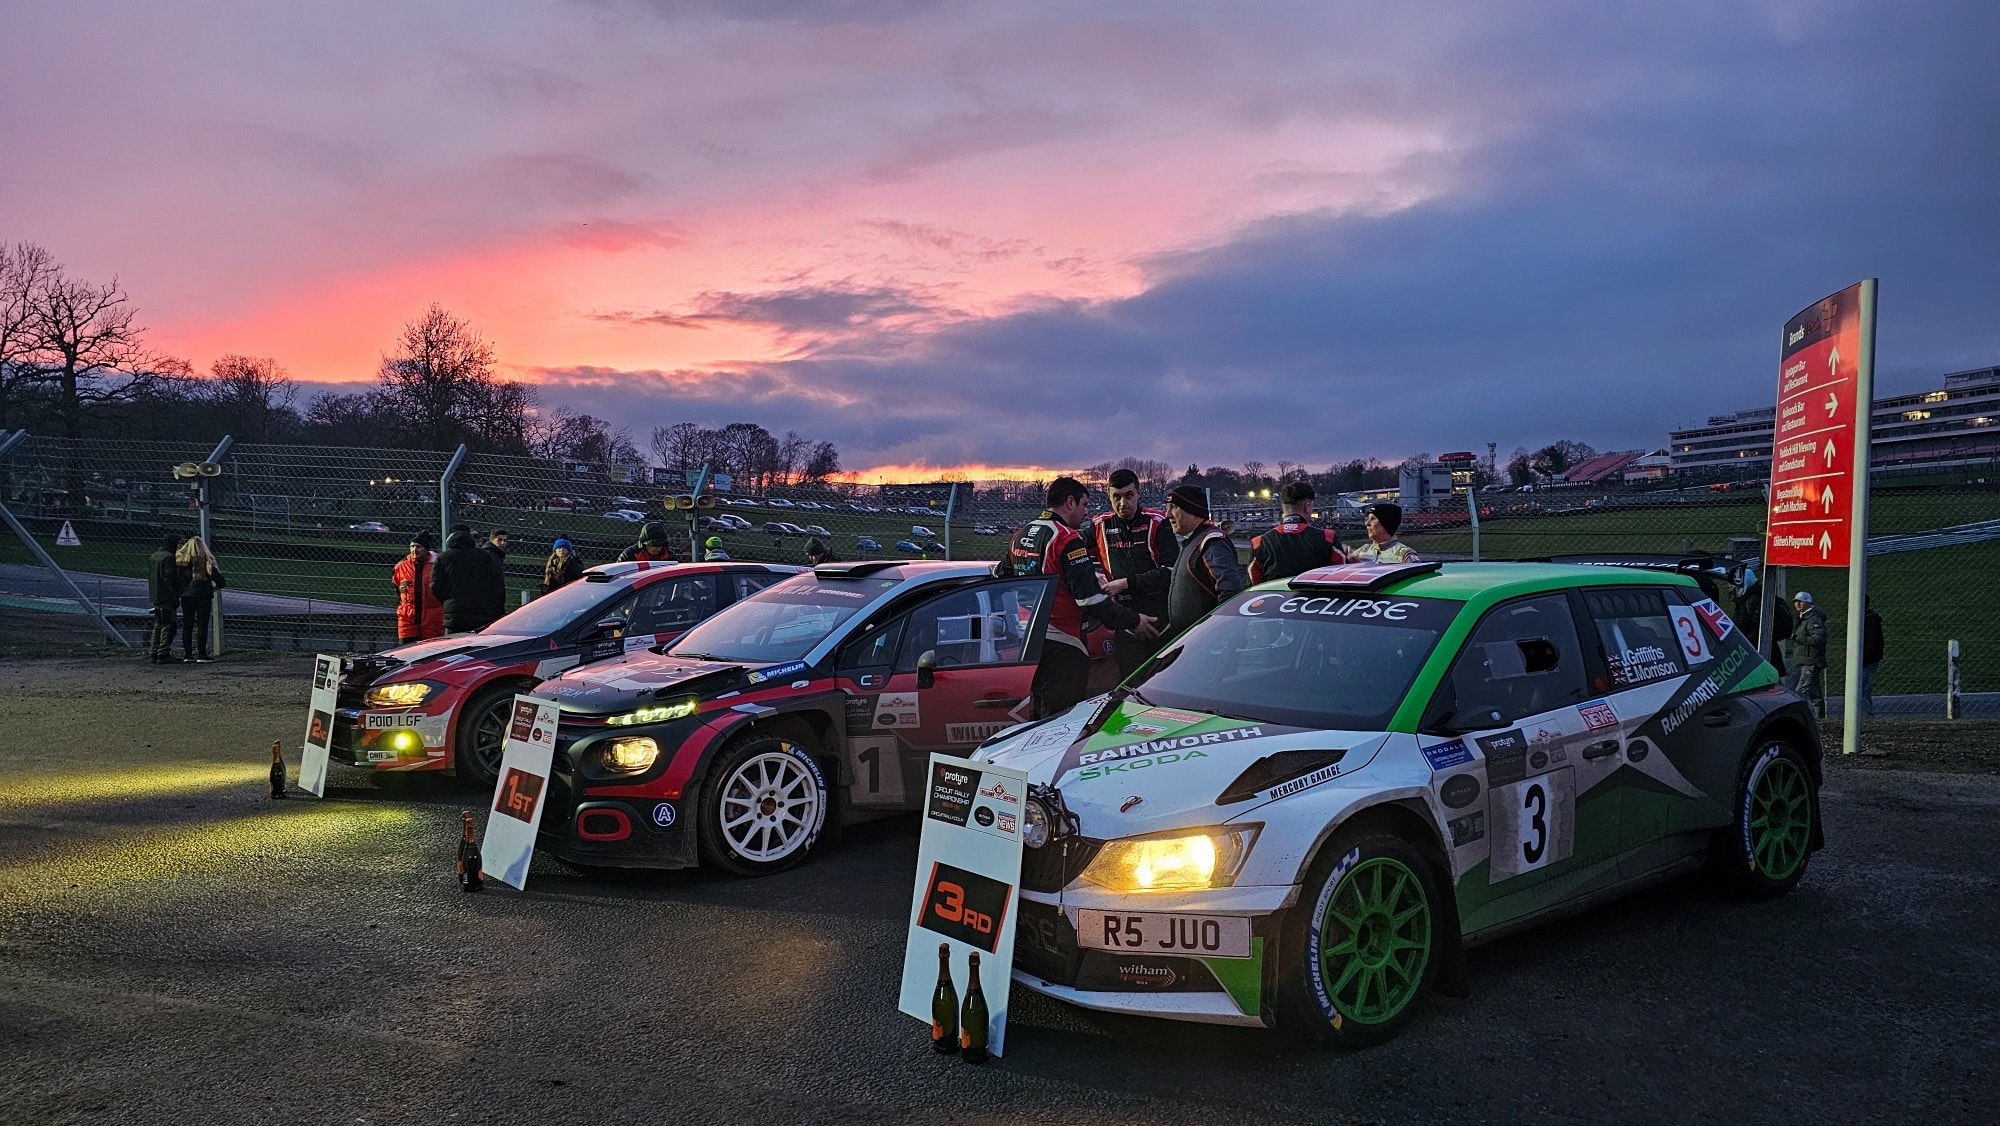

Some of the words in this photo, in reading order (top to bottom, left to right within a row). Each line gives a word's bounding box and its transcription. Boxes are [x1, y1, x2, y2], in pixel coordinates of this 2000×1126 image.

[1789, 325, 1805, 346] Brands
[1788, 373, 1808, 390] Restaurant
[1797, 401, 1805, 412] Bar
[1799, 440, 1817, 453] Viewing
[1789, 500, 1807, 511] Machine
[1788, 534, 1814, 549] Playground
[1279, 597, 1420, 620] ECLIPSE
[1677, 616, 1702, 657] 3
[1621, 646, 1665, 667] J.Griffiths
[767, 663, 804, 677] MICHELIN
[861, 675, 883, 686] C3
[1625, 661, 1678, 684] E.Morrison
[1660, 676, 1720, 736] RAINWORTH
[398, 715, 422, 726] LGF
[1584, 709, 1616, 728] NEWS
[1079, 727, 1262, 766] RAINWORTH
[1491, 737, 1516, 750] protyre
[796, 750, 824, 787] MICHELIN
[858, 747, 880, 793] 1
[944, 771, 968, 785] protyre
[935, 785, 953, 794] CIRCUIT
[954, 789, 970, 798] RALLY
[1270, 776, 1309, 800] MERCURY
[1310, 764, 1341, 784] GARAGE
[507, 775, 533, 813] 1ST
[933, 792, 970, 805] CHAMPIONSHIP
[998, 818, 1015, 831] NEWS
[1523, 783, 1546, 864] 3
[1324, 876, 1337, 900] SPORT
[935, 880, 993, 934] 3RD
[1104, 915, 1143, 947] R5
[1158, 917, 1220, 950] JUO
[1119, 964, 1168, 975] witham
[1310, 934, 1331, 1008] MICHELIN
